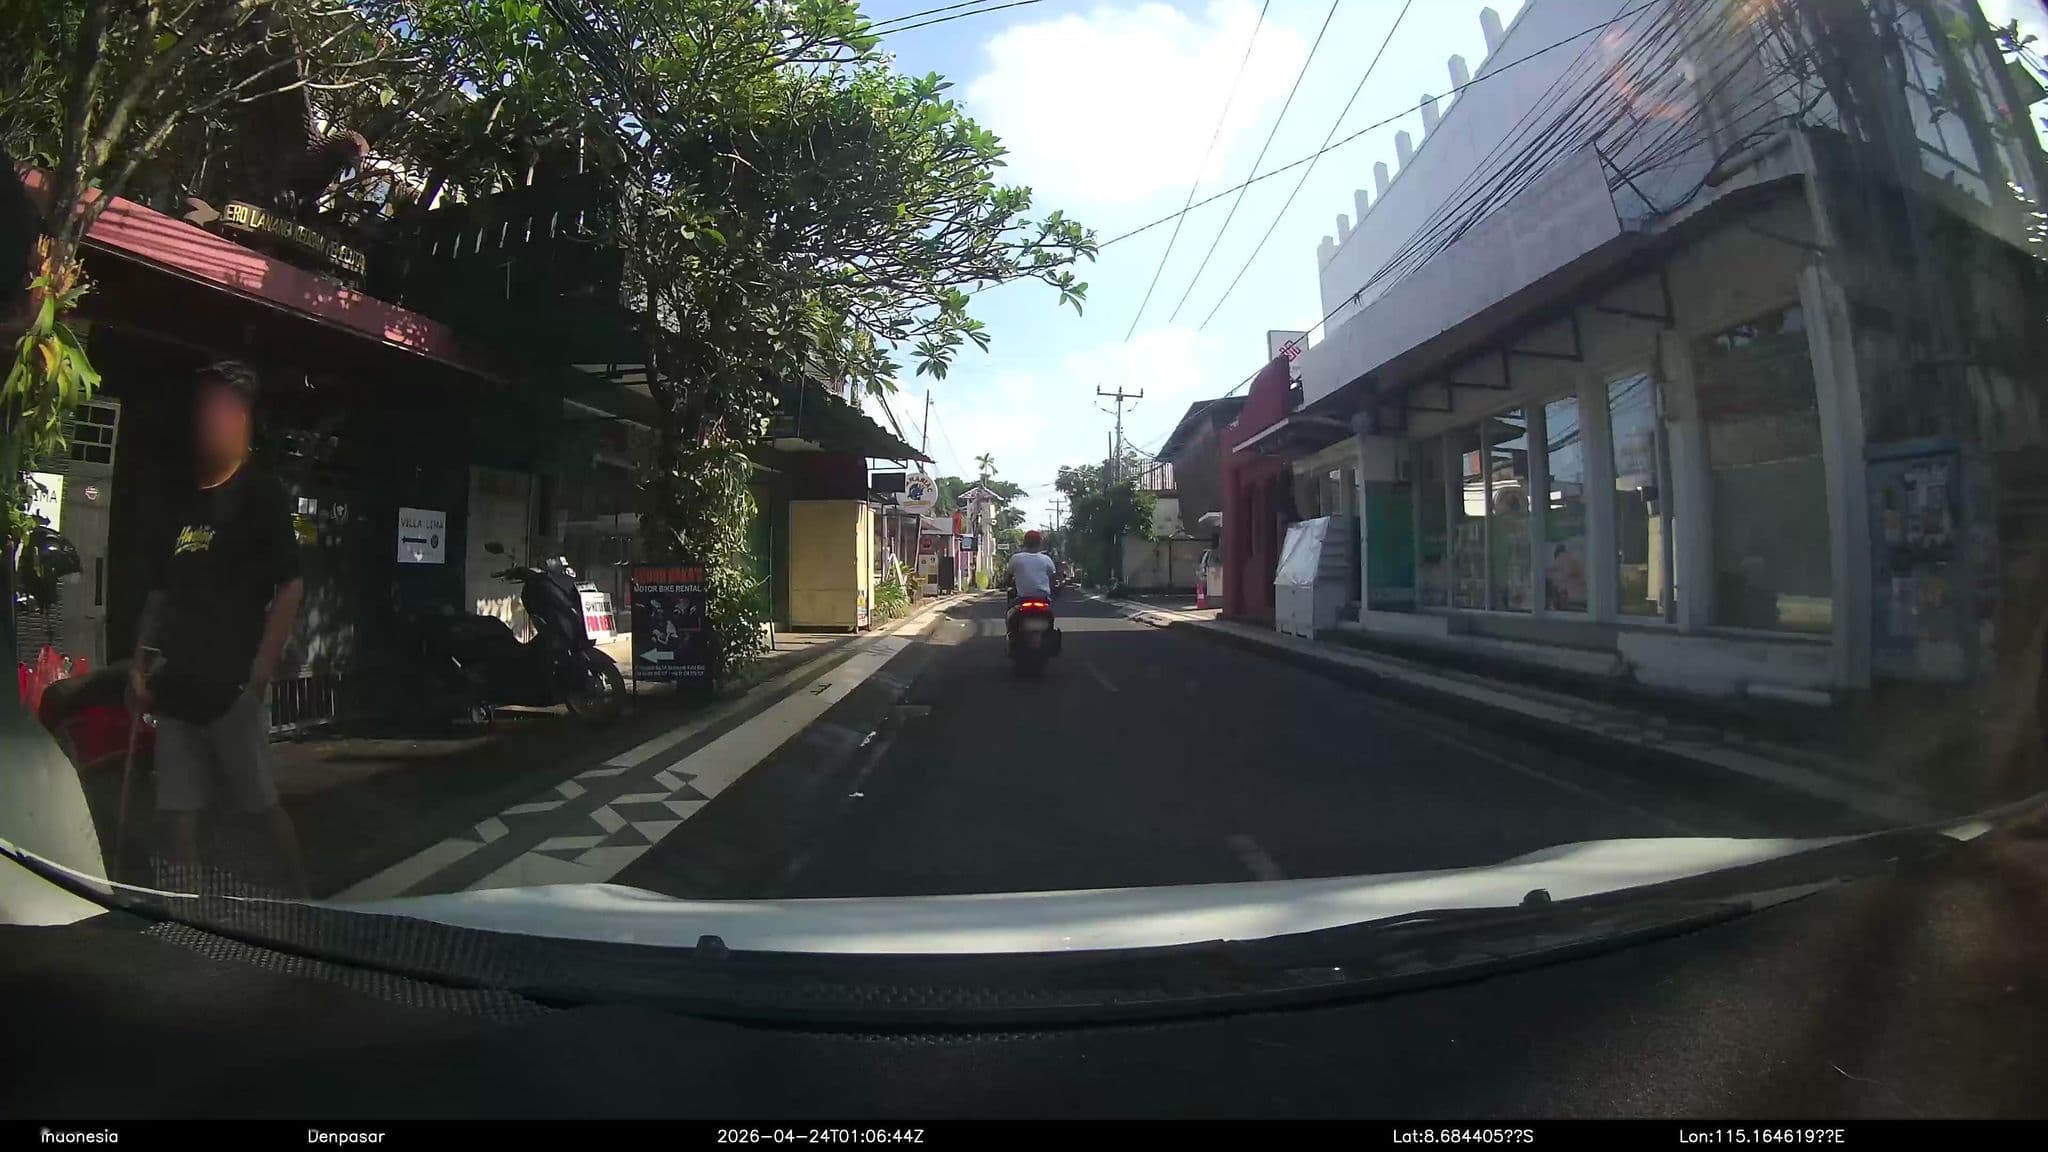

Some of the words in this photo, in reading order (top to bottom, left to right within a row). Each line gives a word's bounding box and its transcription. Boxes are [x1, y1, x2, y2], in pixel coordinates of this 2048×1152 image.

[400, 518, 422, 528] VILLA
[426, 519, 444, 530] LIMA
[634, 583, 658, 593] MOTOR
[658, 584, 675, 593] BIKE
[675, 584, 702, 593] RENTAL
